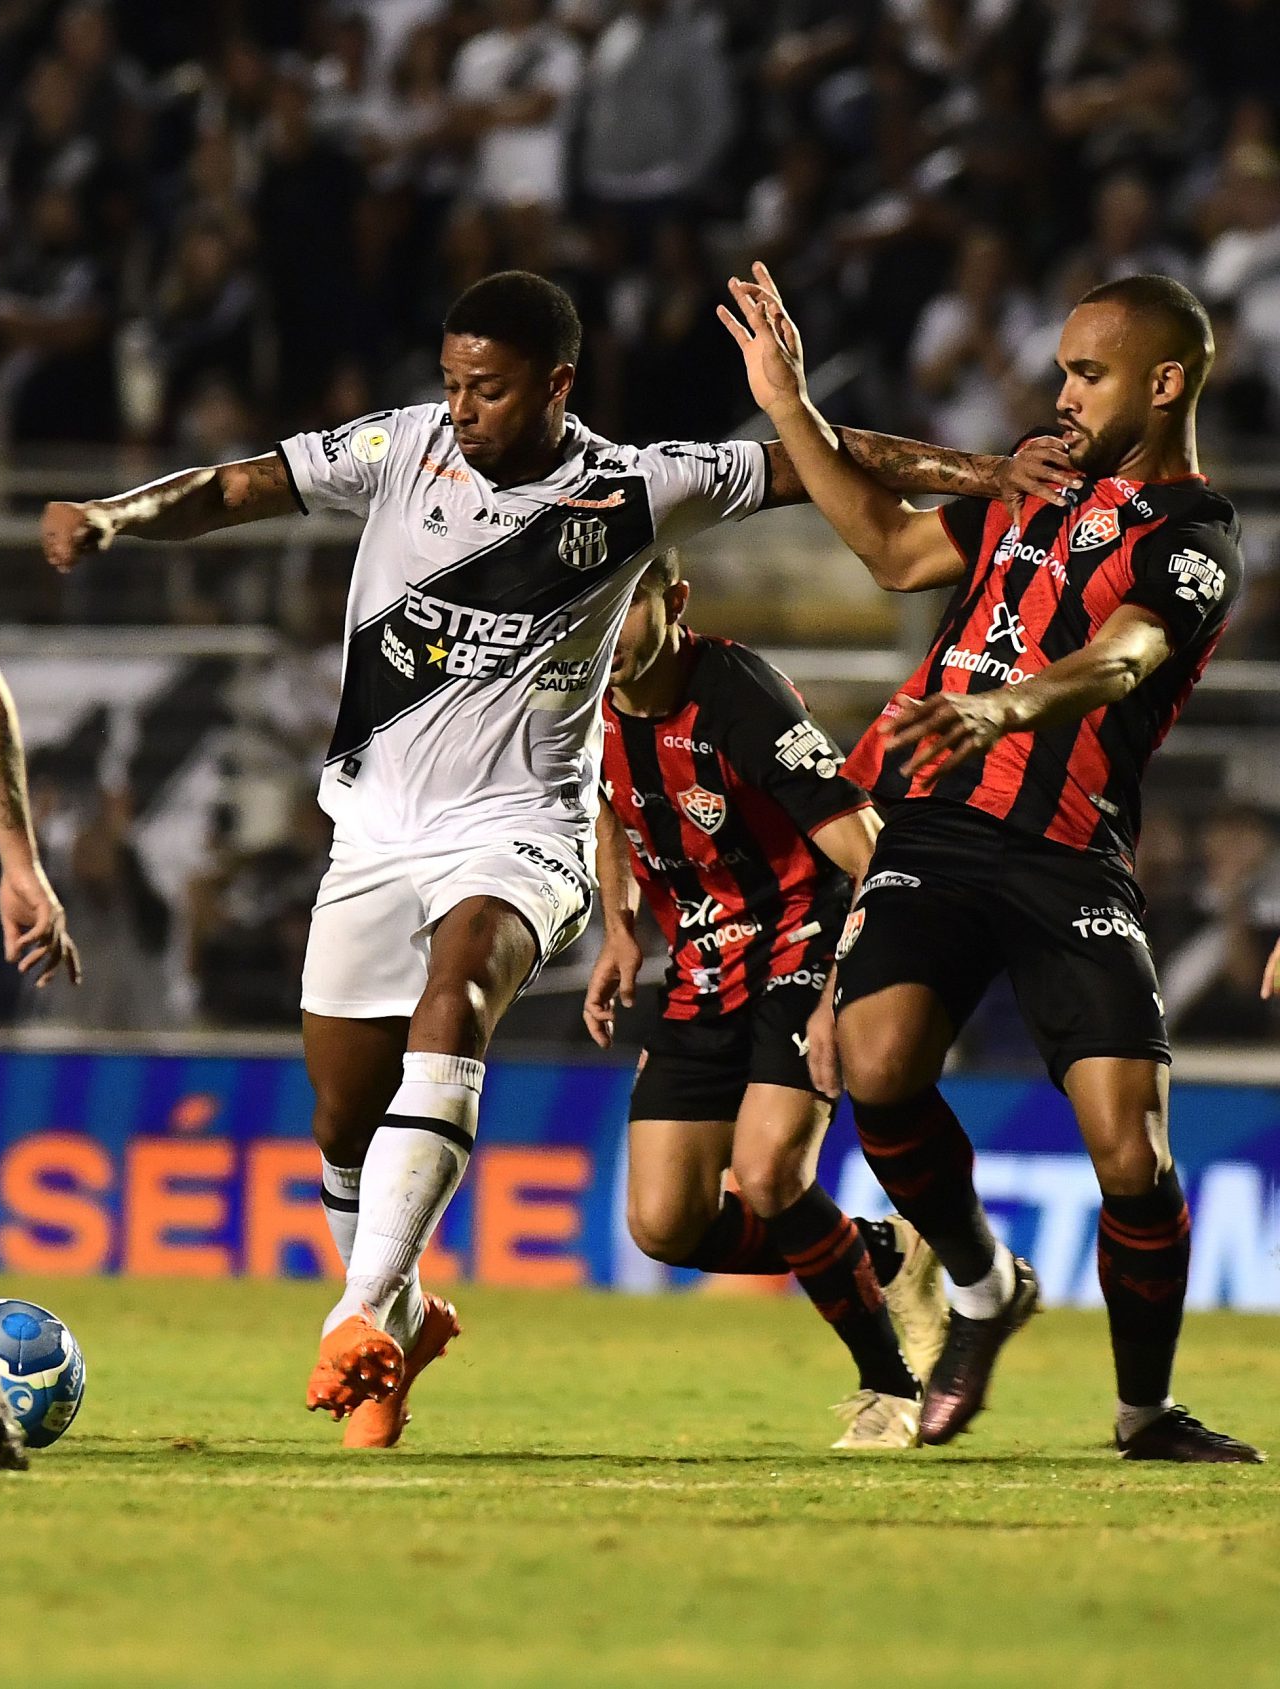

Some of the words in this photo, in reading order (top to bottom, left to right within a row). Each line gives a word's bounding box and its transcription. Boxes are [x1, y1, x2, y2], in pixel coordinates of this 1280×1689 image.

[422, 519, 448, 537] 1900
[490, 513, 526, 529] ADN
[404, 583, 571, 648] ESTRELA
